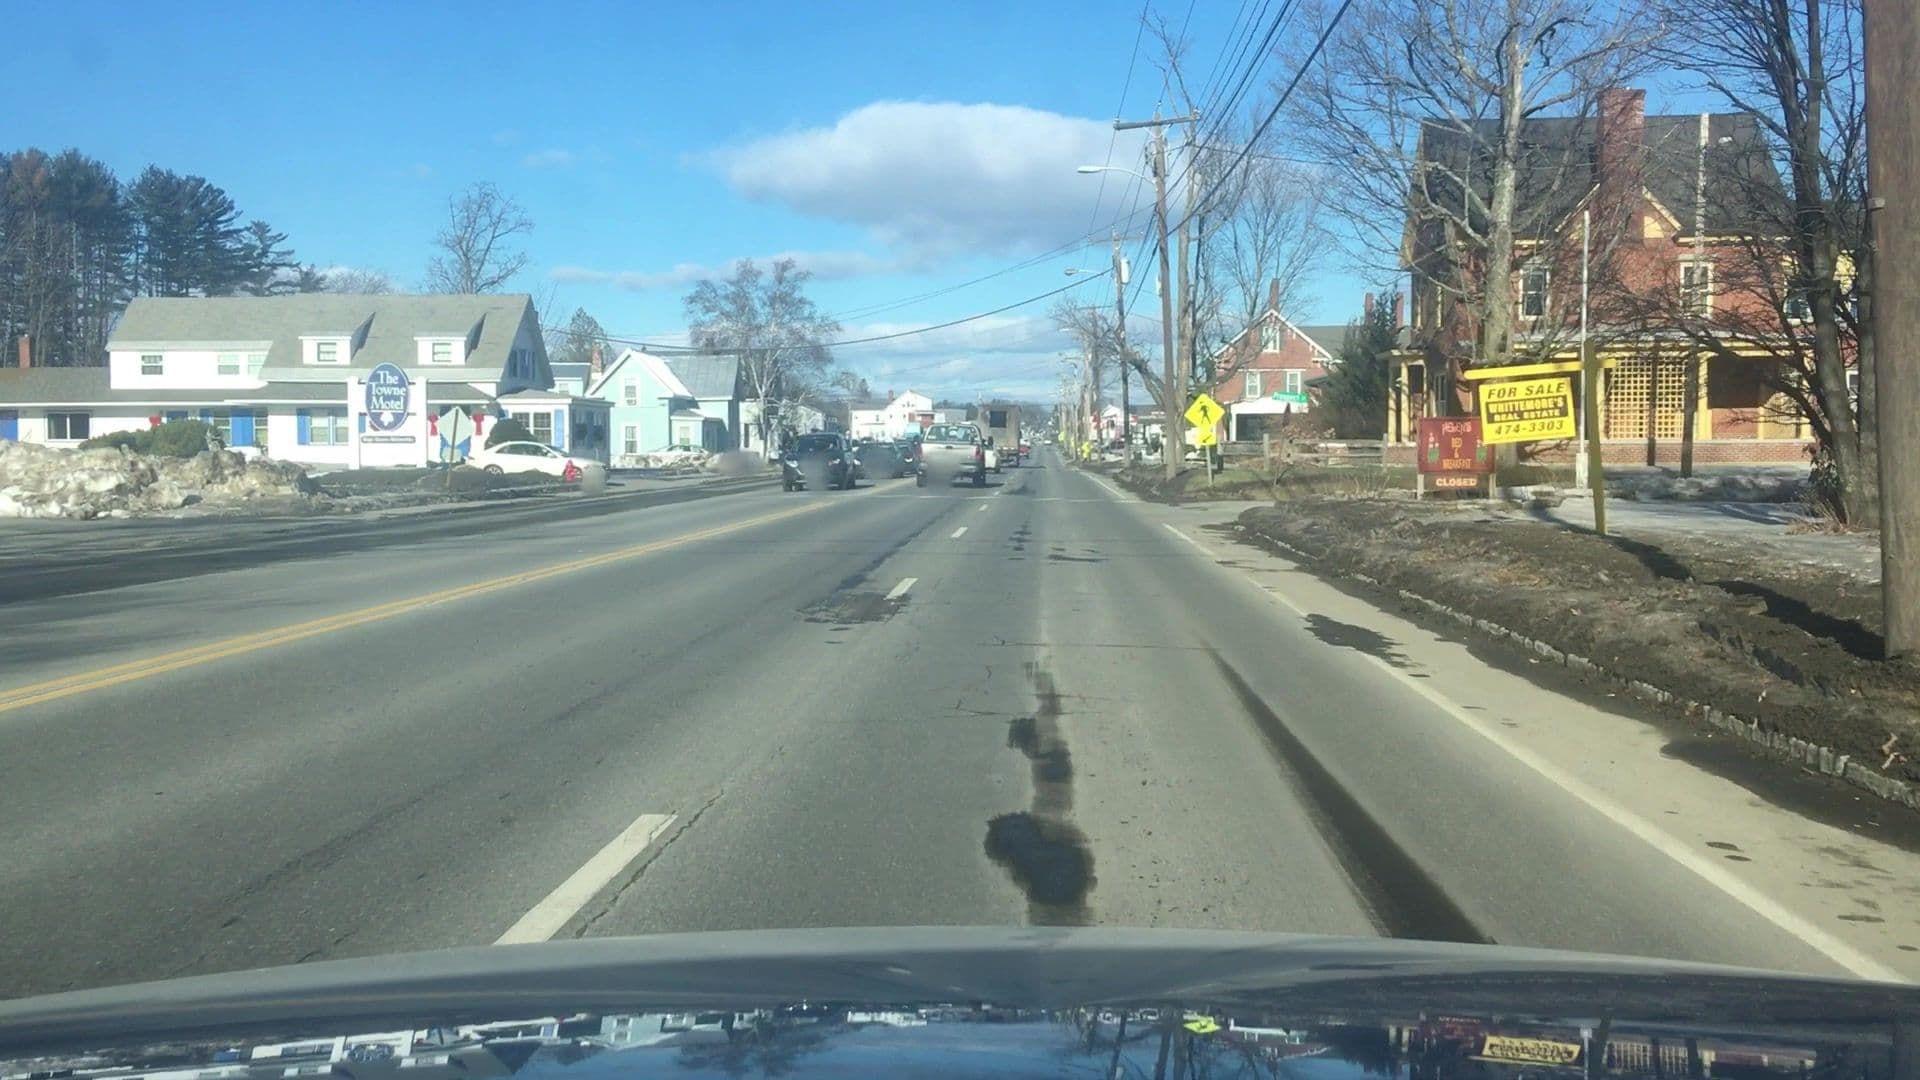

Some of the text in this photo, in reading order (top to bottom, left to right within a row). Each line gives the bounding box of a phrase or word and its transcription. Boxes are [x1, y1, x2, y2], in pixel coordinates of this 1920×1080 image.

[376, 370, 399, 385] The
[369, 382, 407, 396] Towne
[1487, 382, 1566, 400] FOR SALE
[370, 395, 405, 410] Motel
[1488, 397, 1564, 414] WHITTEMORE'S
[1493, 408, 1561, 423] REAL ESTATE
[1495, 420, 1565, 436] 474-3303
[1435, 477, 1478, 488] CLOSED
